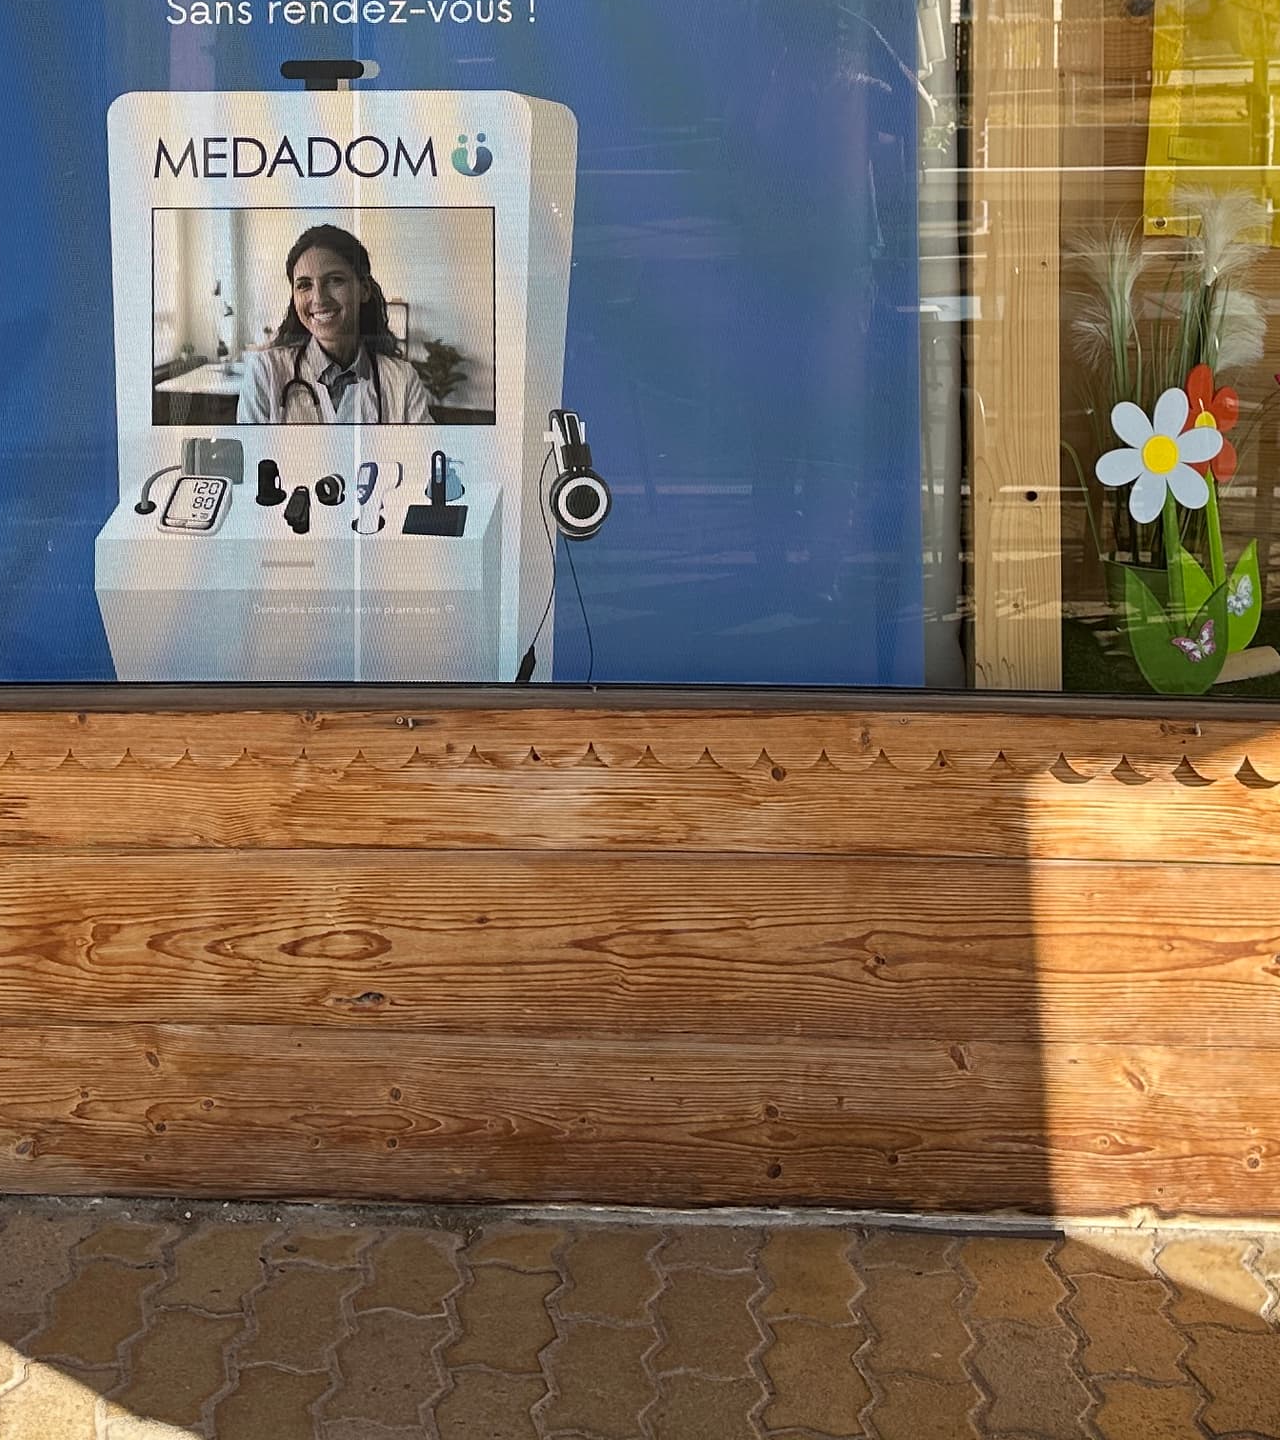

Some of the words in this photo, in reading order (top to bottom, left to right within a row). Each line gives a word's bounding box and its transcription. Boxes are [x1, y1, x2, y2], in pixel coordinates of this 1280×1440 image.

[152, 134, 439, 179] MEDADOM
[193, 481, 220, 495] 120
[192, 496, 216, 510] 80
